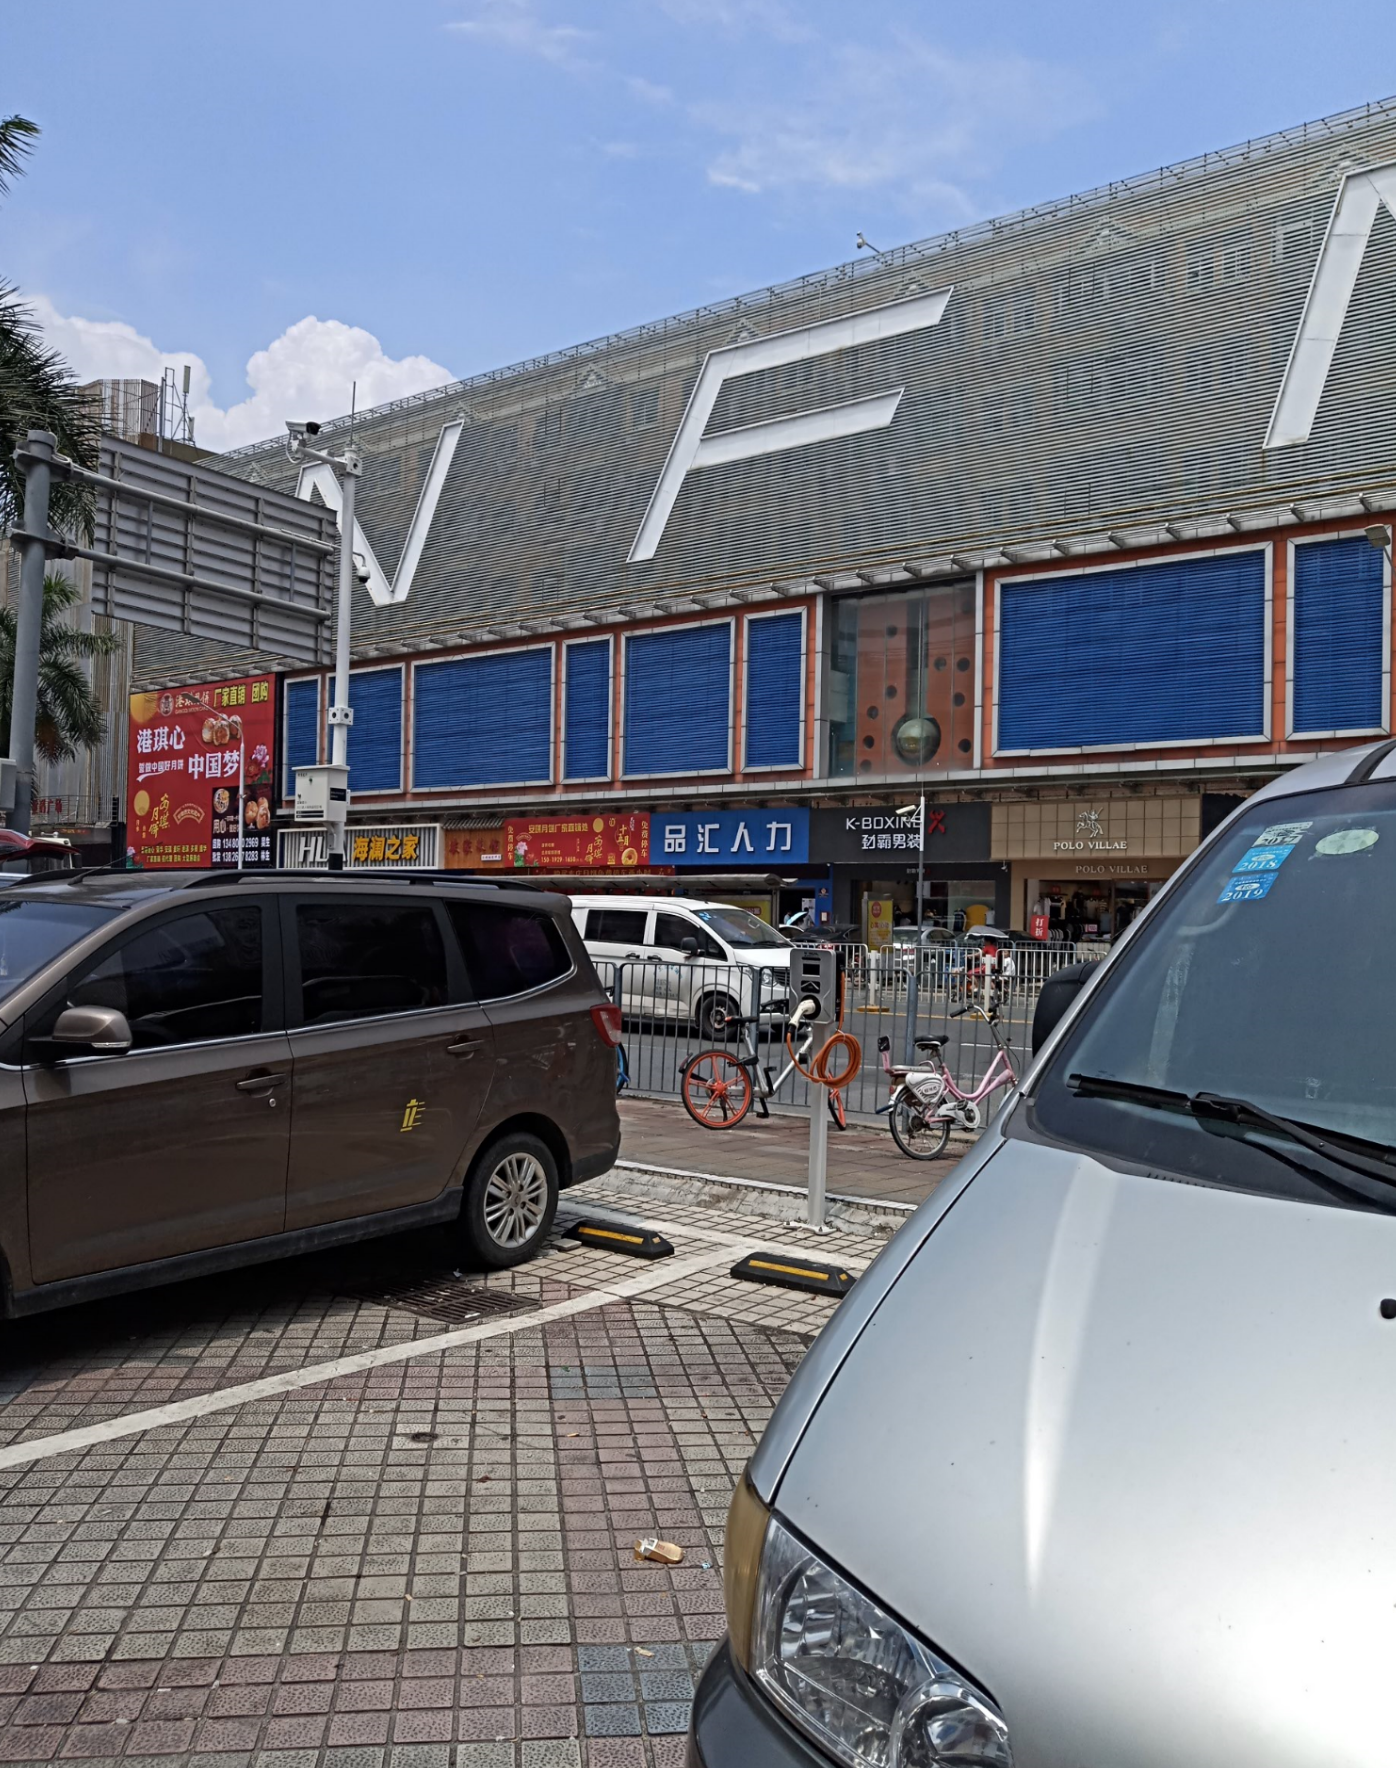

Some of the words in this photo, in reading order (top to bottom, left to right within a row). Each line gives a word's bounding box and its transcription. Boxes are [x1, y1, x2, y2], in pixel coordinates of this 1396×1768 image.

[213, 684, 246, 708] 厂家直销
[251, 680, 269, 704] 团购
[137, 725, 185, 753] 港琪心
[188, 750, 240, 780] 中国梦
[664, 821, 792, 853] 品汇人力
[861, 833, 921, 850] 劲霸男装
[1053, 841, 1084, 850] POLO
[1088, 841, 1128, 850] VILLAE
[352, 833, 419, 862] 海澜之家
[1075, 865, 1105, 874] POLO
[1109, 864, 1148, 873] VILLAE
[1237, 859, 1278, 872] 2018
[1220, 888, 1264, 902] 2019
[1035, 917, 1045, 937] 打折
